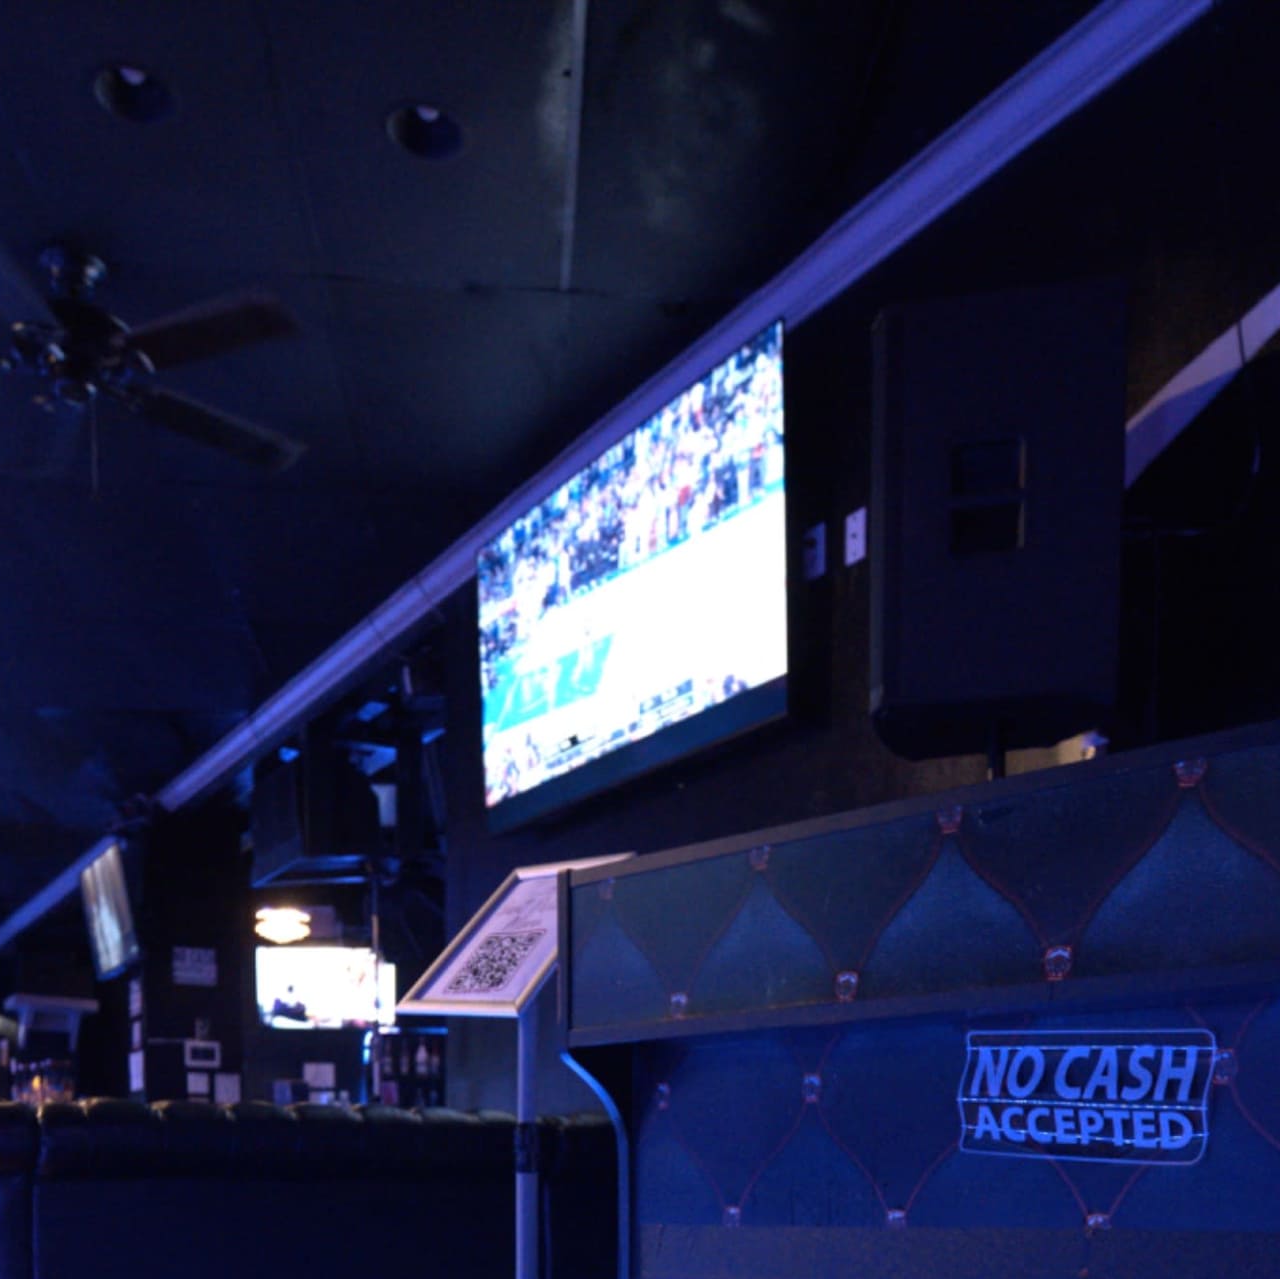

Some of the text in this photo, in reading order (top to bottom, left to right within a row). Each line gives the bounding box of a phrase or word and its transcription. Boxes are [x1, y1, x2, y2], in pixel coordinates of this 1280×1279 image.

[970, 1044, 1199, 1103] NO CASH
[972, 1106, 1195, 1150] ACCEPTED
